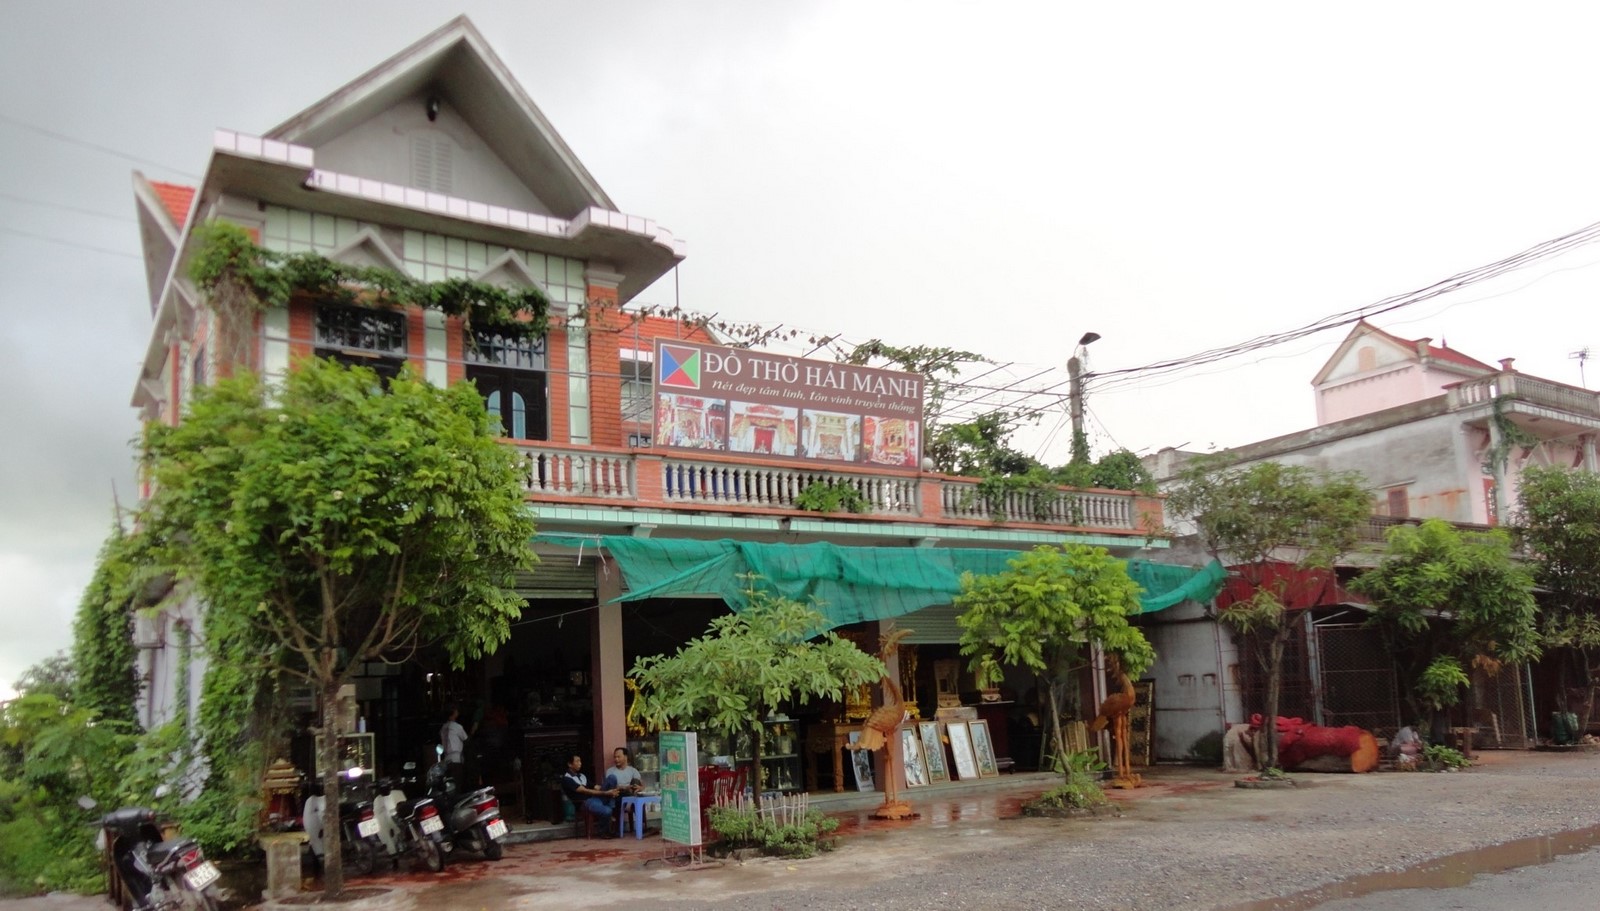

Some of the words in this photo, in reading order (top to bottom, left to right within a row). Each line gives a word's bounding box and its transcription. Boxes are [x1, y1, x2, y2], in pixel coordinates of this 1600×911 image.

[704, 350, 742, 376] ĐỒ
[748, 358, 799, 383] THỜ
[804, 363, 846, 389] HẢI
[852, 372, 919, 399] MẠNH
